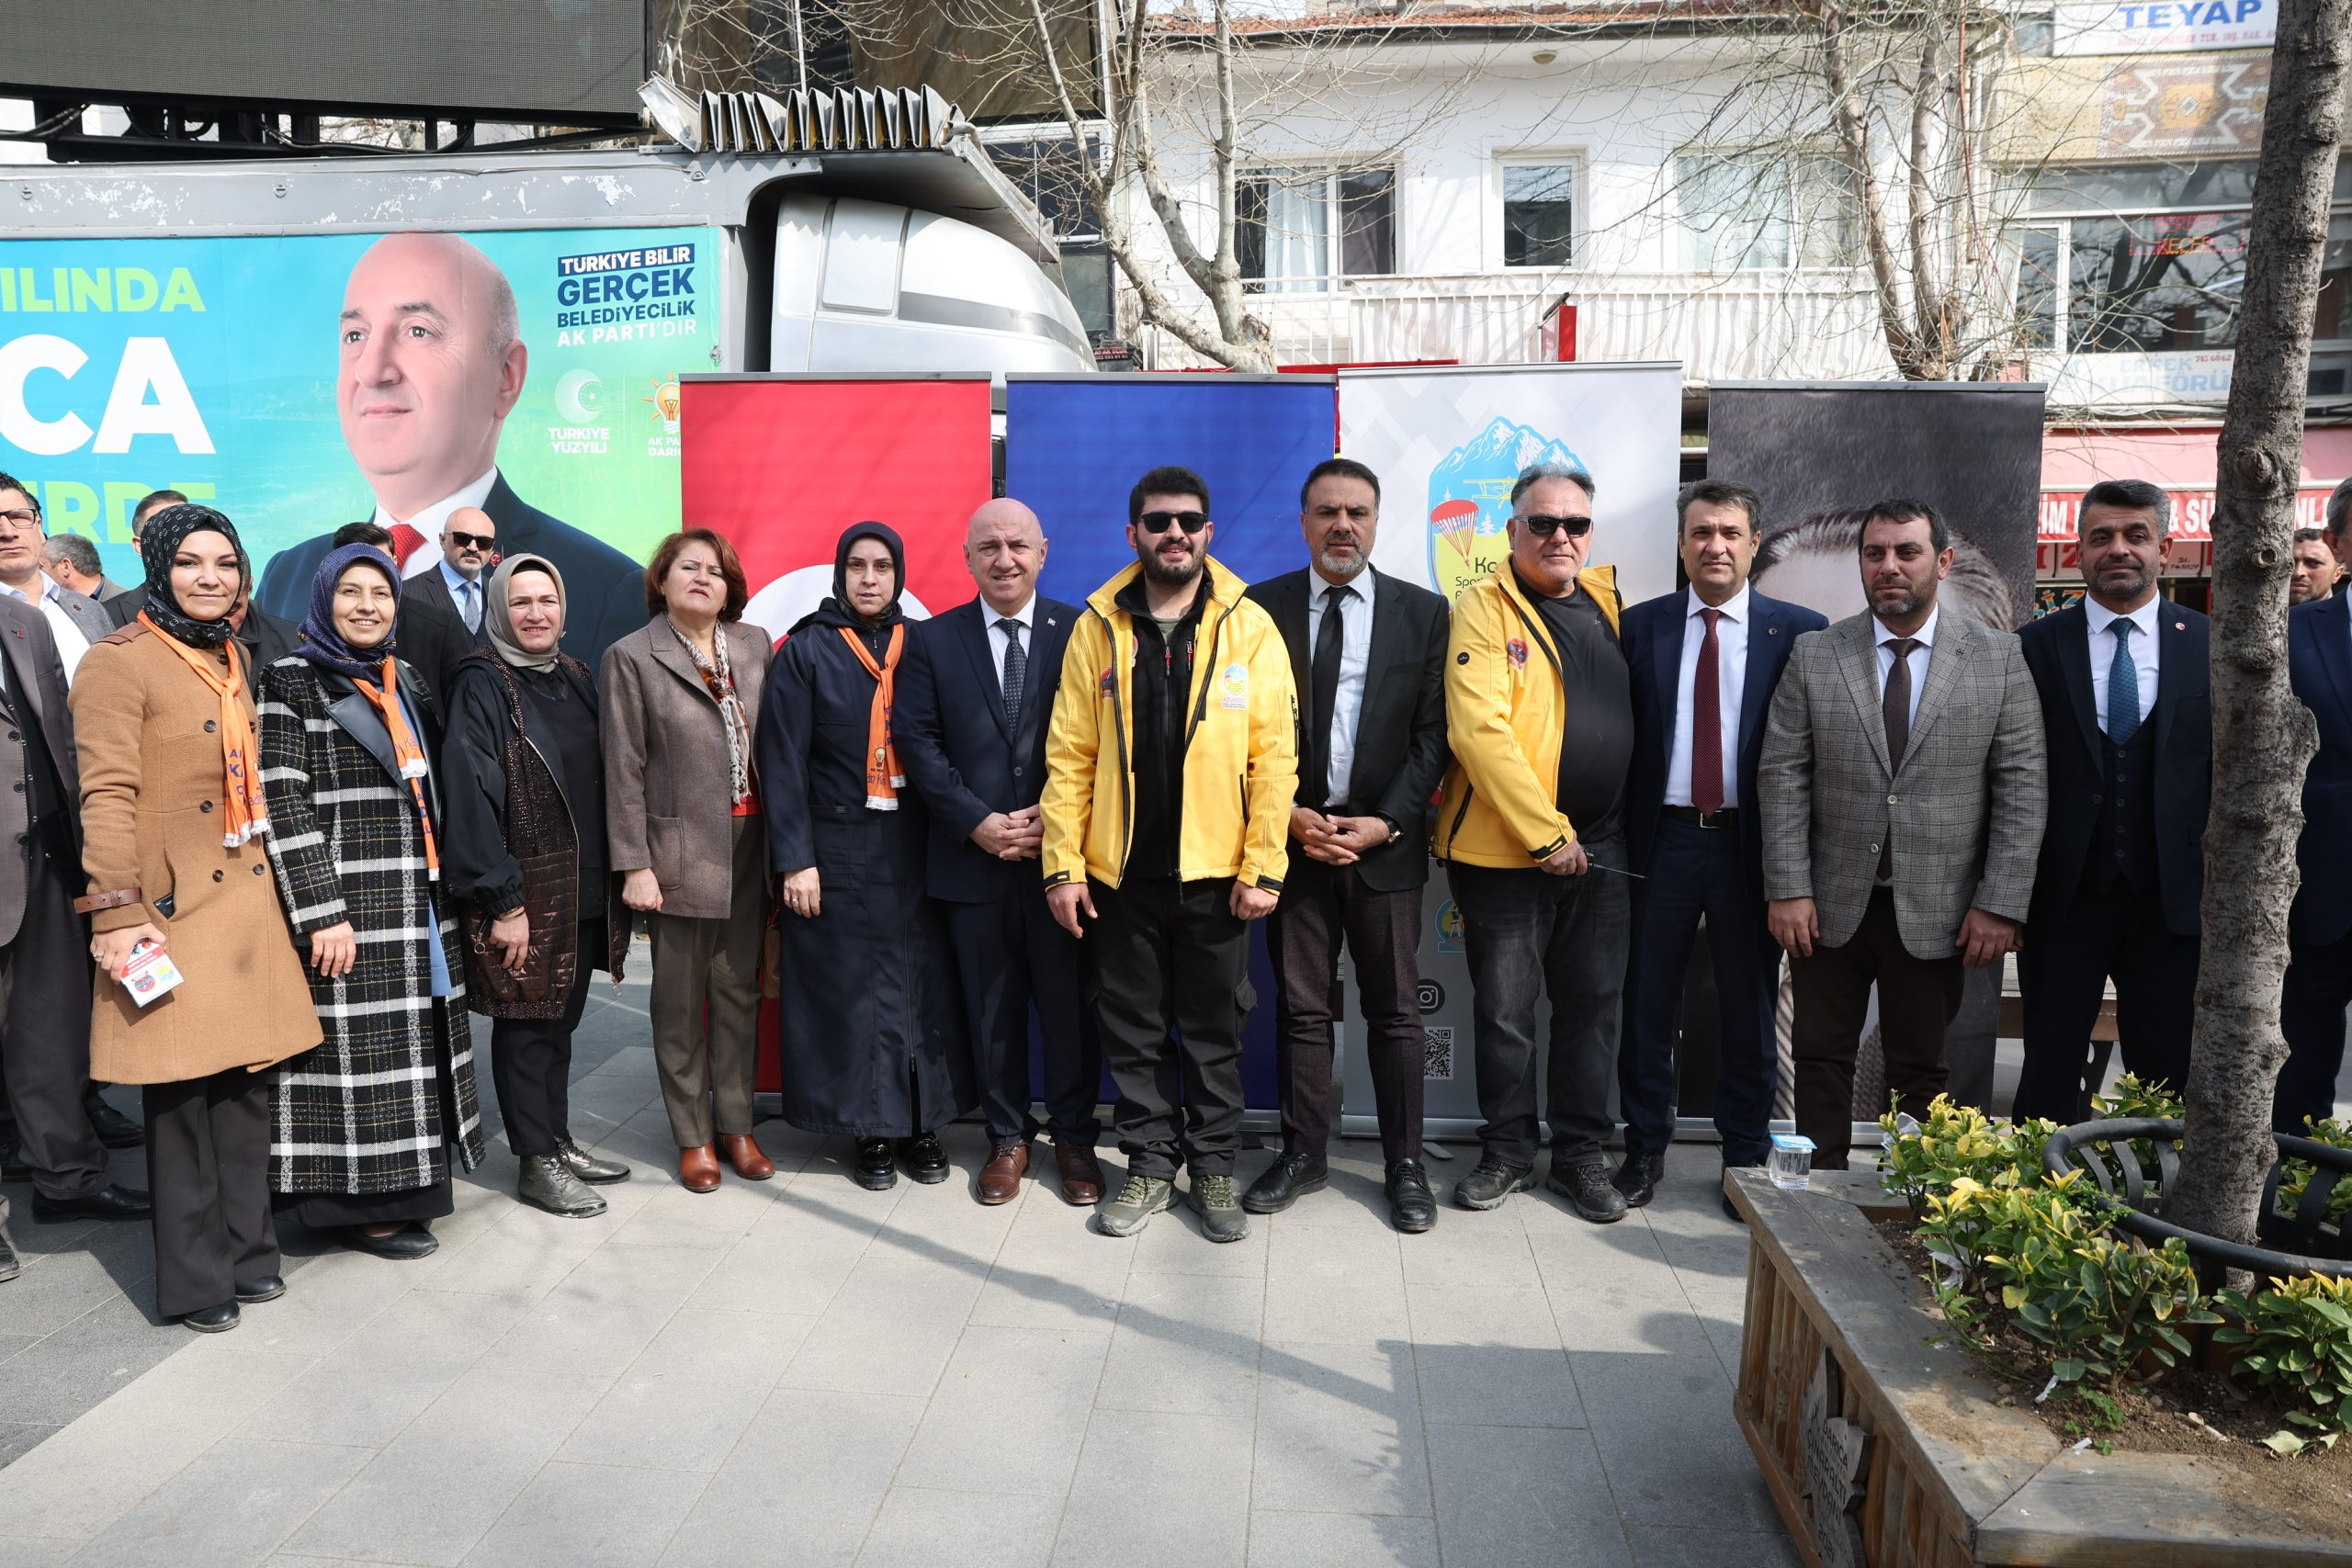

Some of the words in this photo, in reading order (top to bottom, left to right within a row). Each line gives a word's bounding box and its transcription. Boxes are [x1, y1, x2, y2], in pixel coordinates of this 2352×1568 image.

[2117, 0, 2263, 29] TEYAP
[557, 266, 695, 307] GERÇEK
[557, 299, 695, 328] BELEDİYECİLİK
[557, 329, 586, 348] AK
[0, 333, 218, 456] CA
[648, 437, 662, 446] AK
[1823, 1419, 1849, 1468] DARICA
